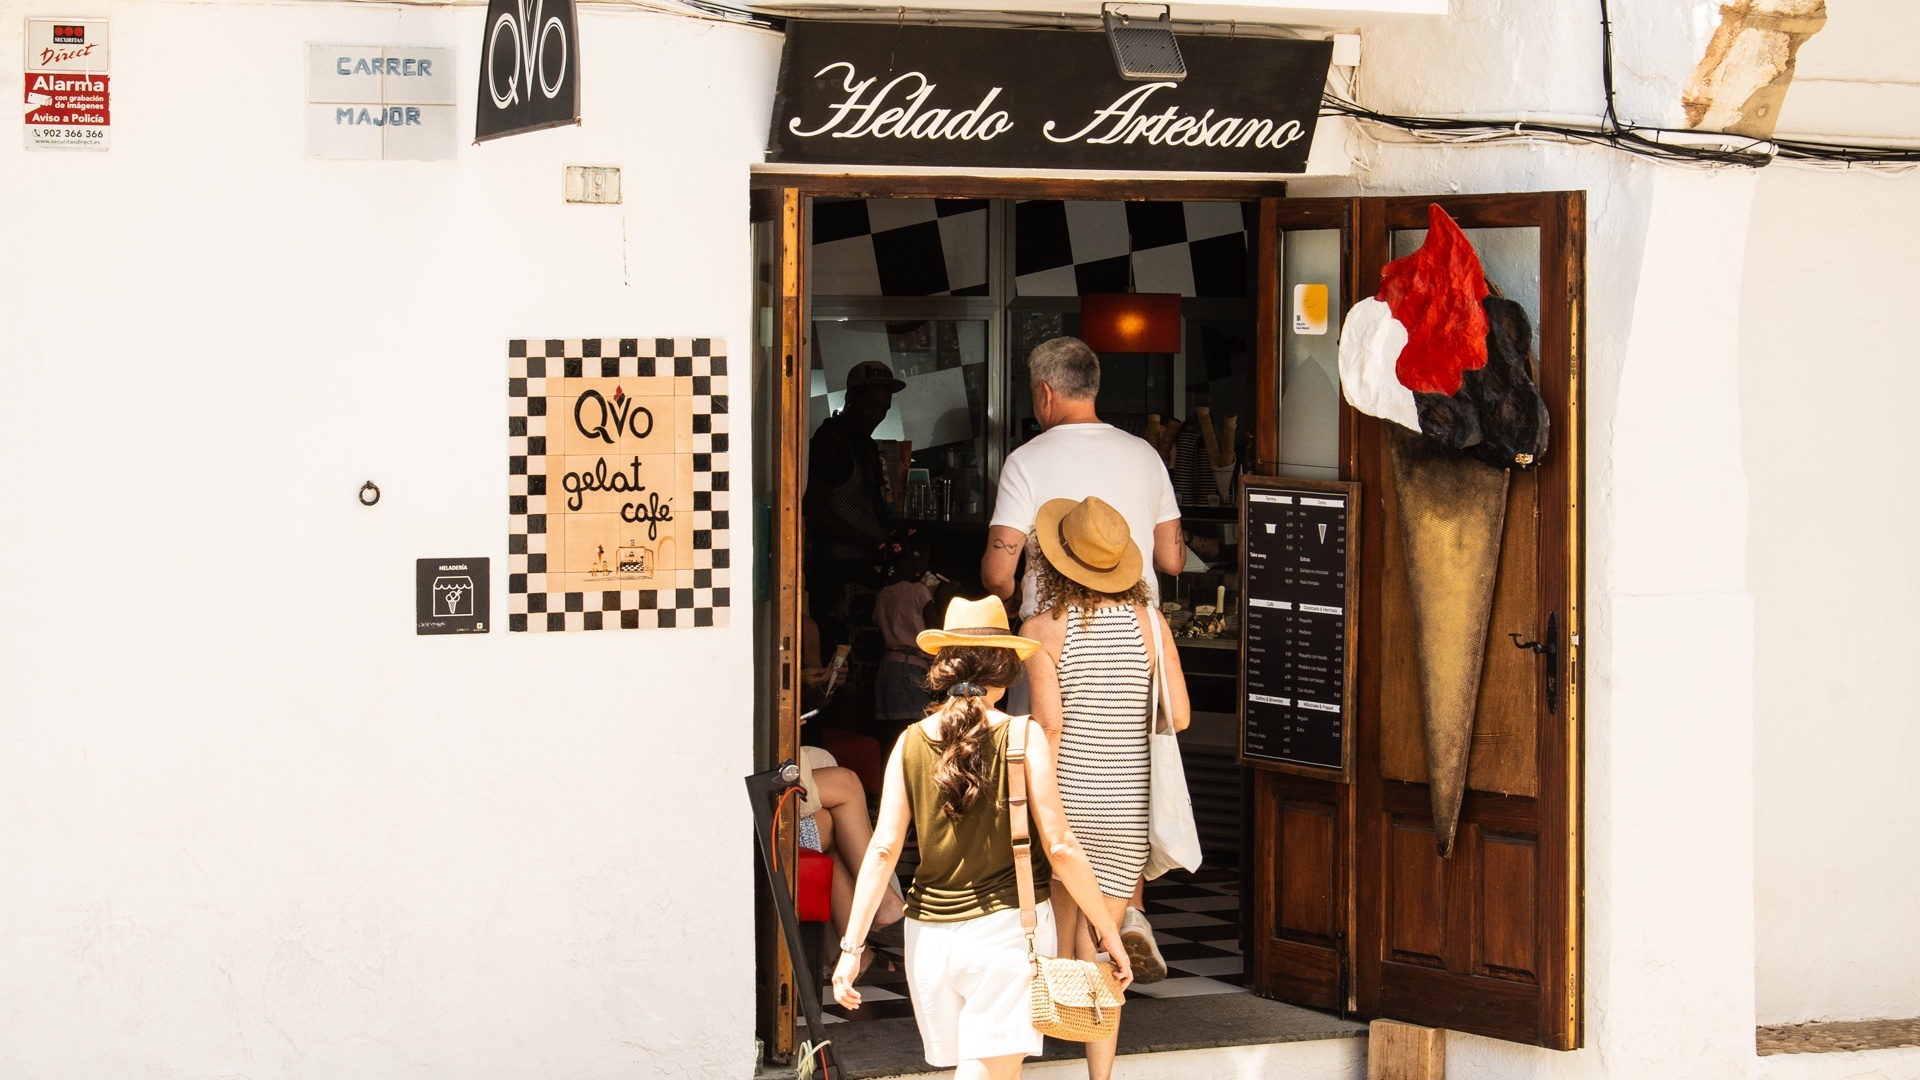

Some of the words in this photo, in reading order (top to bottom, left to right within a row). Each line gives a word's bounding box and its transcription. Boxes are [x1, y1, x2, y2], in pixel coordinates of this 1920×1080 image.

[40, 43, 99, 66] Direct
[336, 57, 432, 77] CARRER
[32, 75, 104, 92] Alarma
[67, 102, 104, 111] imágenes
[69, 95, 104, 103] grabación
[789, 62, 1013, 141] Helado
[1043, 81, 1304, 149] Artesano
[32, 113, 60, 122] Aviso
[72, 113, 104, 123] Policía
[335, 106, 422, 127] MAJOR
[43, 129, 61, 138] 902
[65, 129, 82, 138] 366
[86, 130, 103, 138] 366
[562, 455, 646, 511] gelat
[621, 492, 673, 541] café
